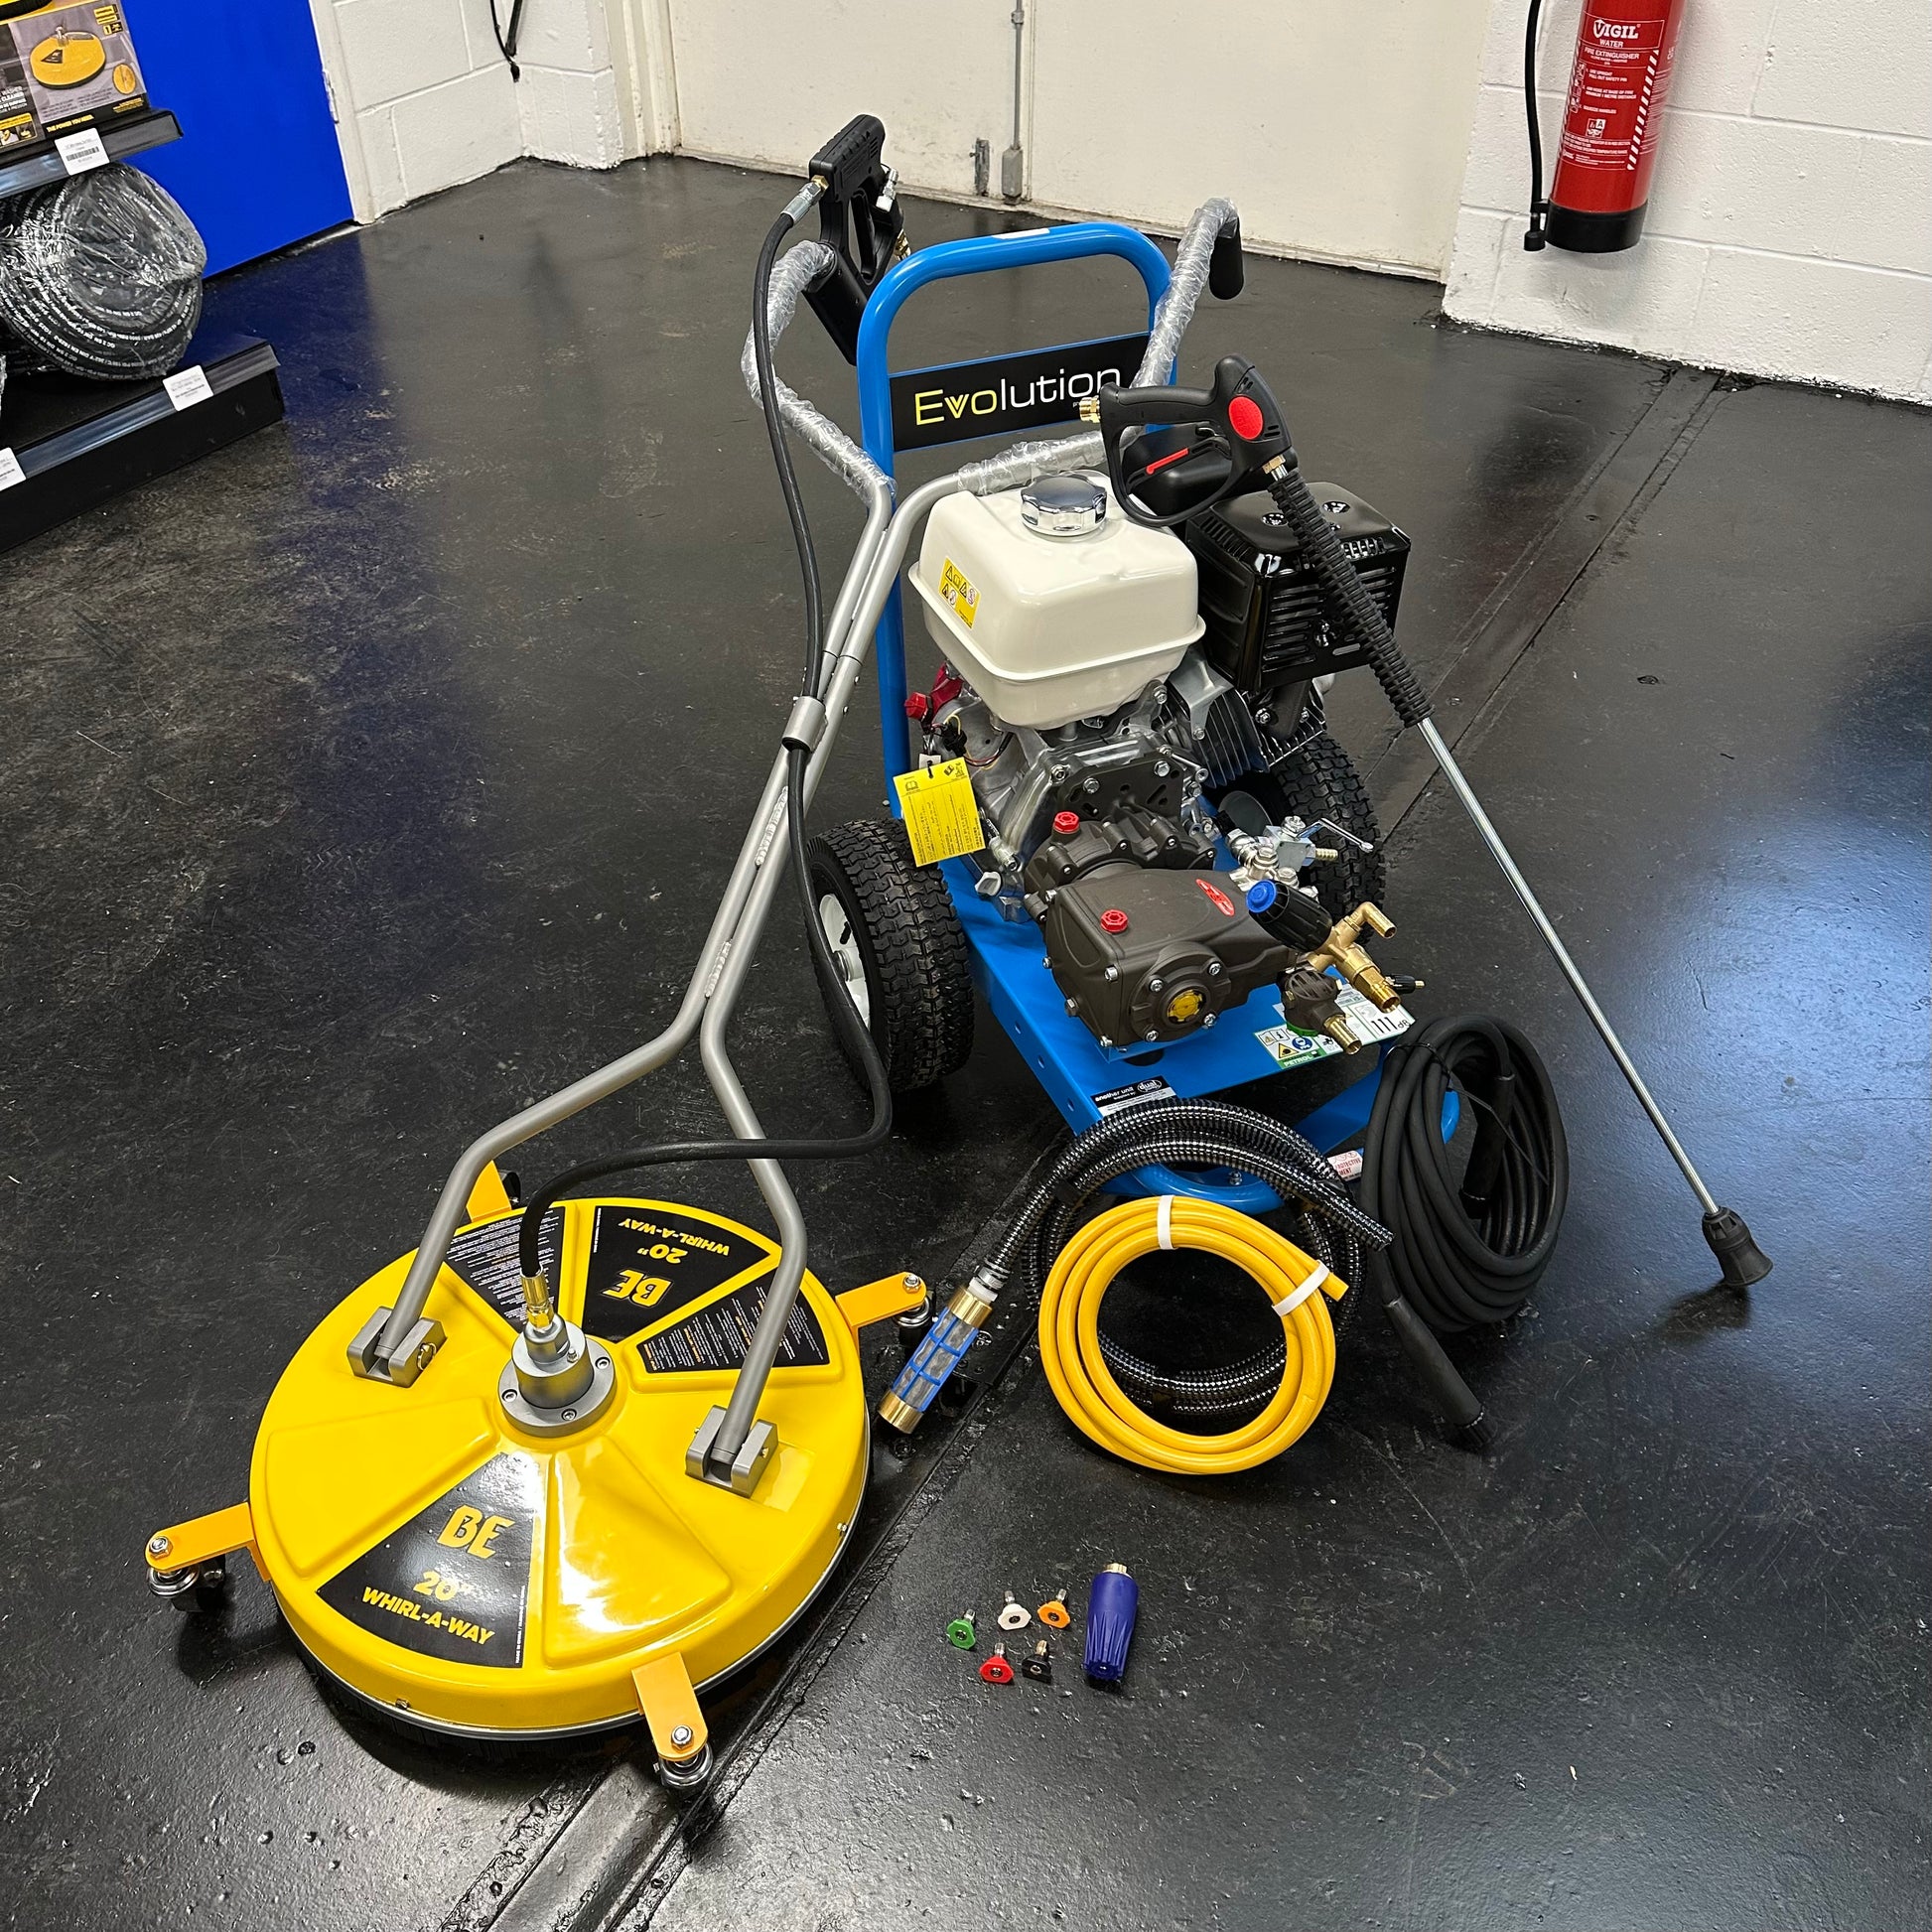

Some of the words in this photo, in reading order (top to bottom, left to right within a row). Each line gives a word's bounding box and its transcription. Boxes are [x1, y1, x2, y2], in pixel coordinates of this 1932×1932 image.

[1593, 20, 1638, 39] VIGIL
[1599, 39, 1624, 48] WATER
[1595, 48, 1640, 59] EXTINGUISHER
[913, 367, 1121, 426] Evolution
[1370, 1017, 1398, 1034] 111
[1283, 1054, 1312, 1066] PETROL
[1139, 1079, 1158, 1090] dual
[1095, 1090, 1119, 1102] another
[619, 1217, 730, 1257] WHIRL-A-WAY
[602, 1269, 673, 1308] BE
[437, 1504, 515, 1560] BE
[361, 1587, 495, 1645] WHIRL-A-WAY
